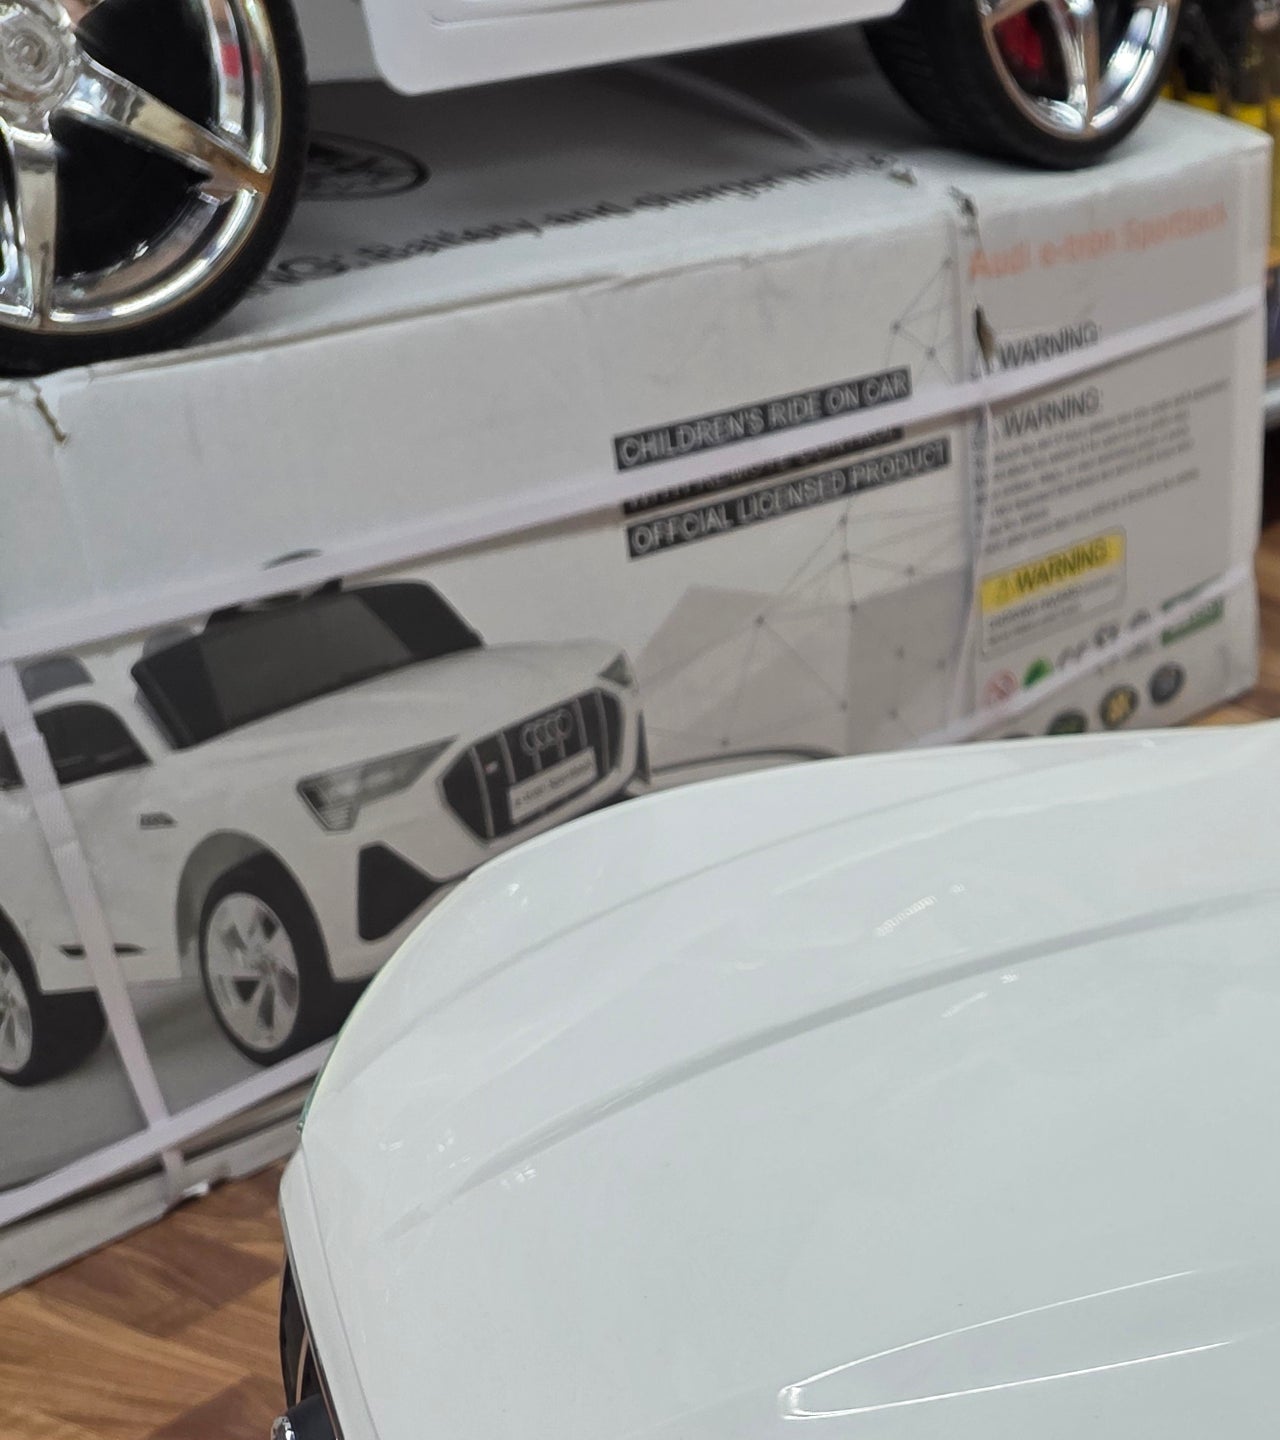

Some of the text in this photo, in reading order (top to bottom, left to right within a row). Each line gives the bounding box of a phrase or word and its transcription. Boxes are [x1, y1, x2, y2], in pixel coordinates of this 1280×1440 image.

[767, 396, 822, 428] RIDE
[824, 386, 861, 414] ON
[862, 371, 909, 403] CAR
